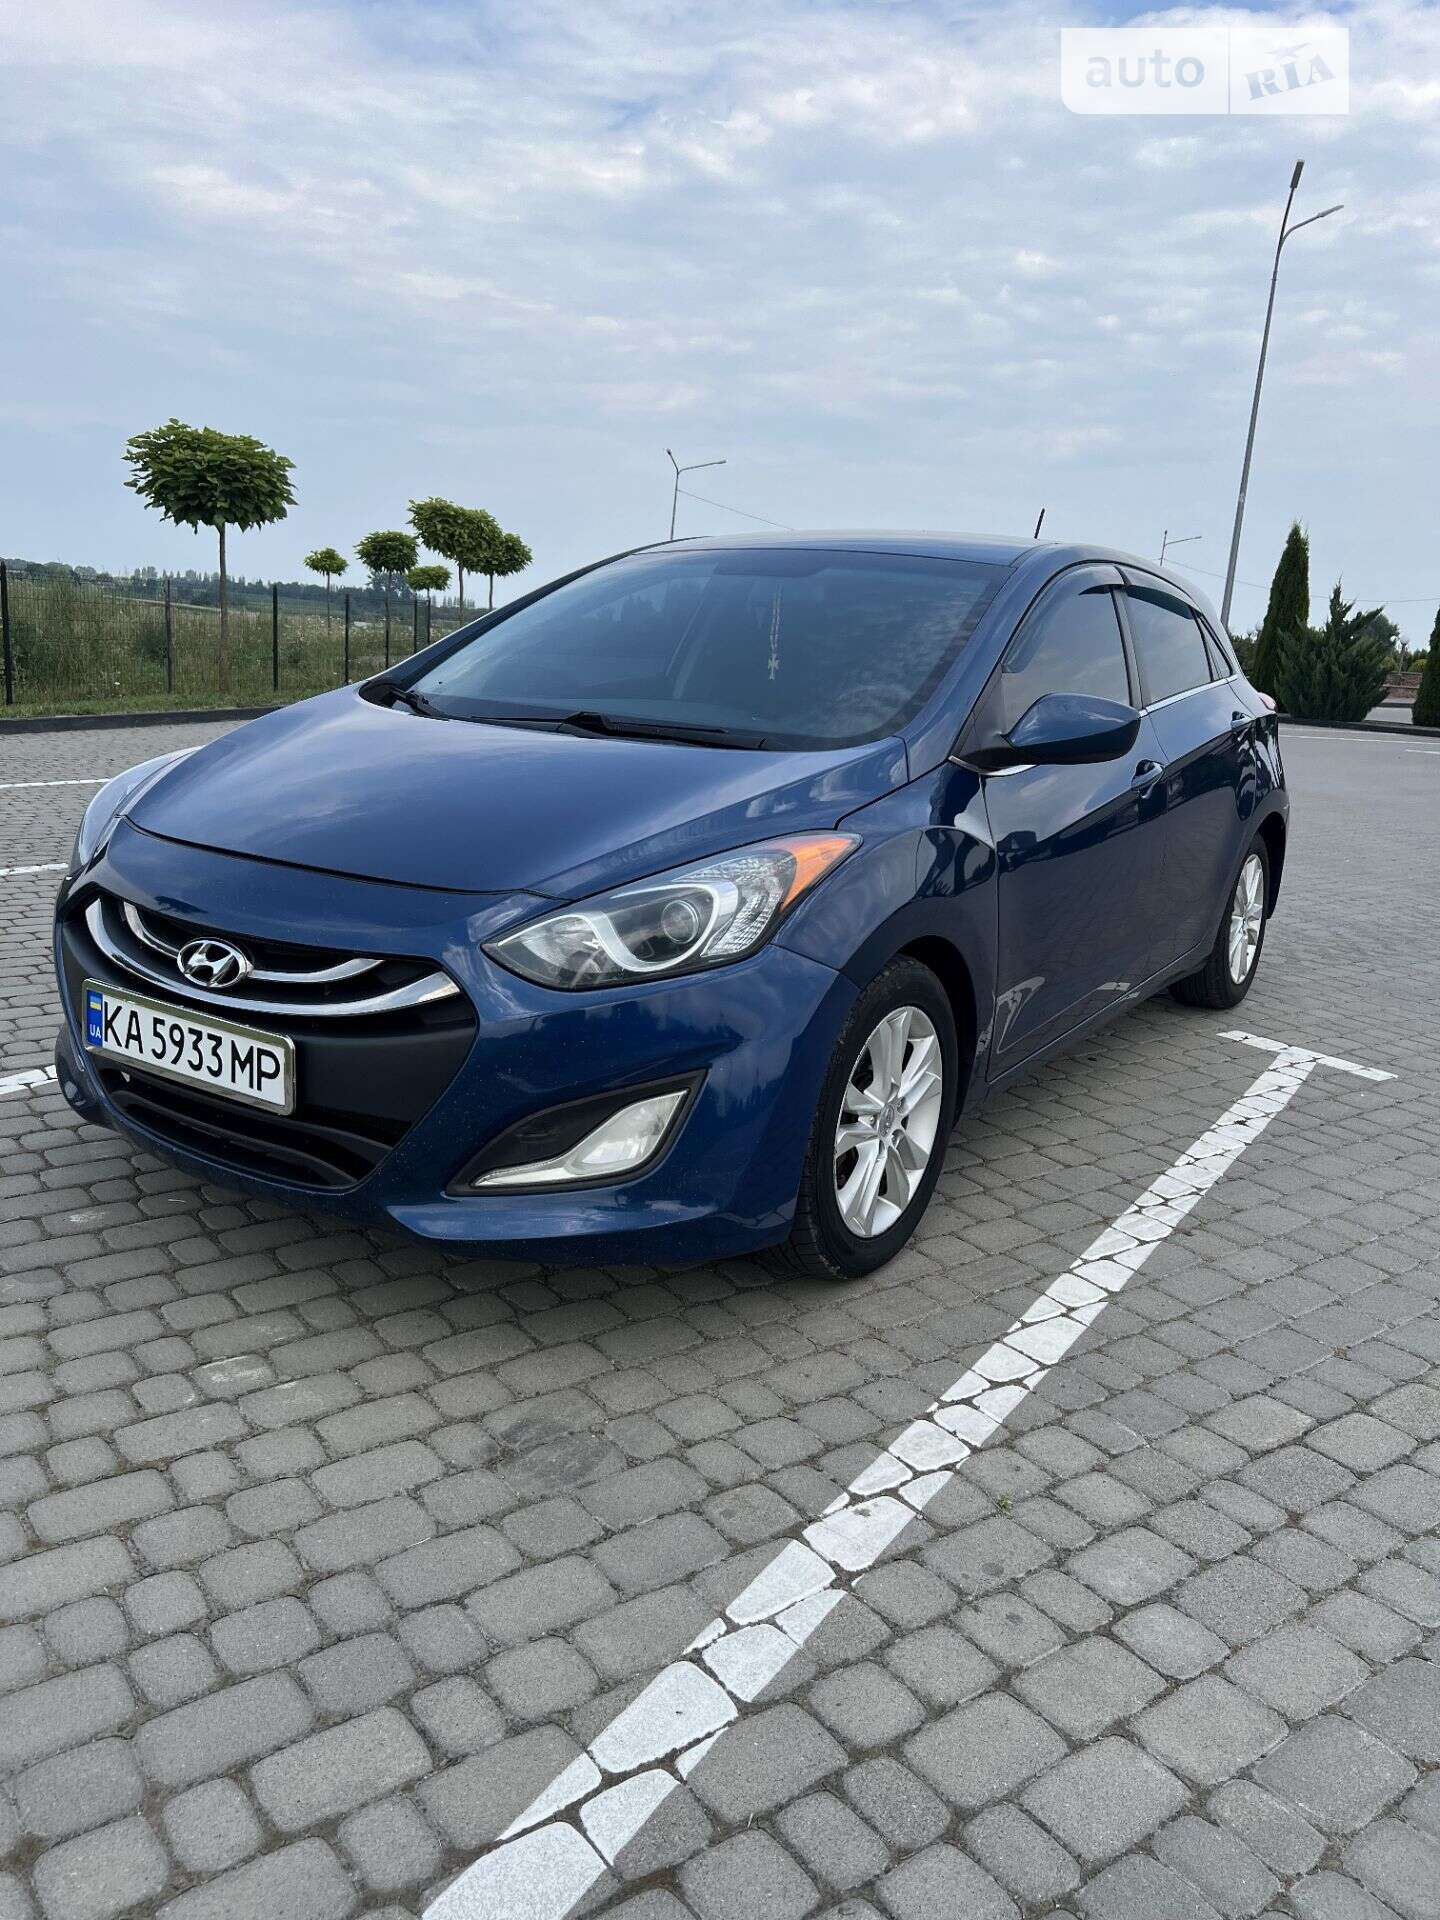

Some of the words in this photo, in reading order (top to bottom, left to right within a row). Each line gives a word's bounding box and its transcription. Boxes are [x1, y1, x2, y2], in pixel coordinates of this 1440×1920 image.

[89, 1023, 102, 1040] UA
[103, 1001, 144, 1054] KA
[151, 1016, 223, 1078] 5933
[230, 1039, 281, 1092] MP
